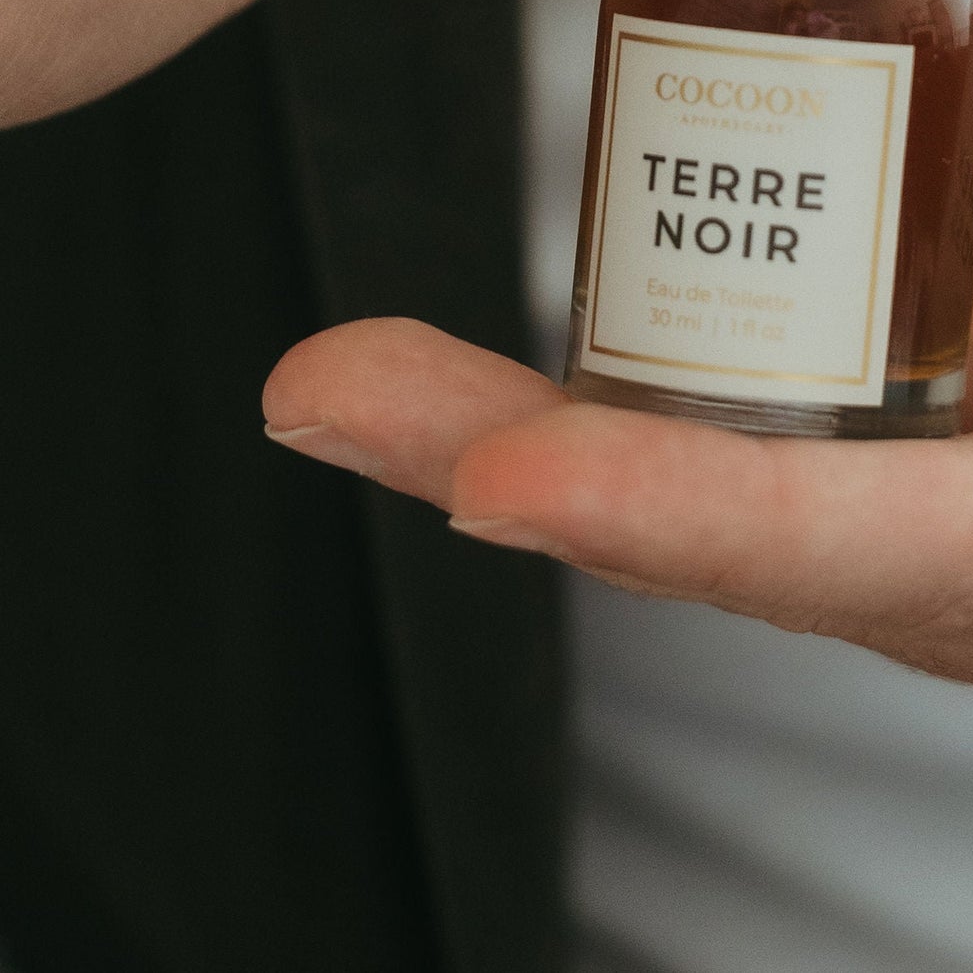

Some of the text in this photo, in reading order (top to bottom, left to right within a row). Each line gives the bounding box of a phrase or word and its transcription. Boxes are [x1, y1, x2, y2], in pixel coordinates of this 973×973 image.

[655, 72, 828, 119] COCOON
[643, 153, 825, 210] TERRE
[654, 210, 798, 263] NOIR
[646, 277, 681, 300] Eau
[686, 282, 713, 304] de
[649, 306, 672, 326] 30
[675, 313, 703, 332] ml
